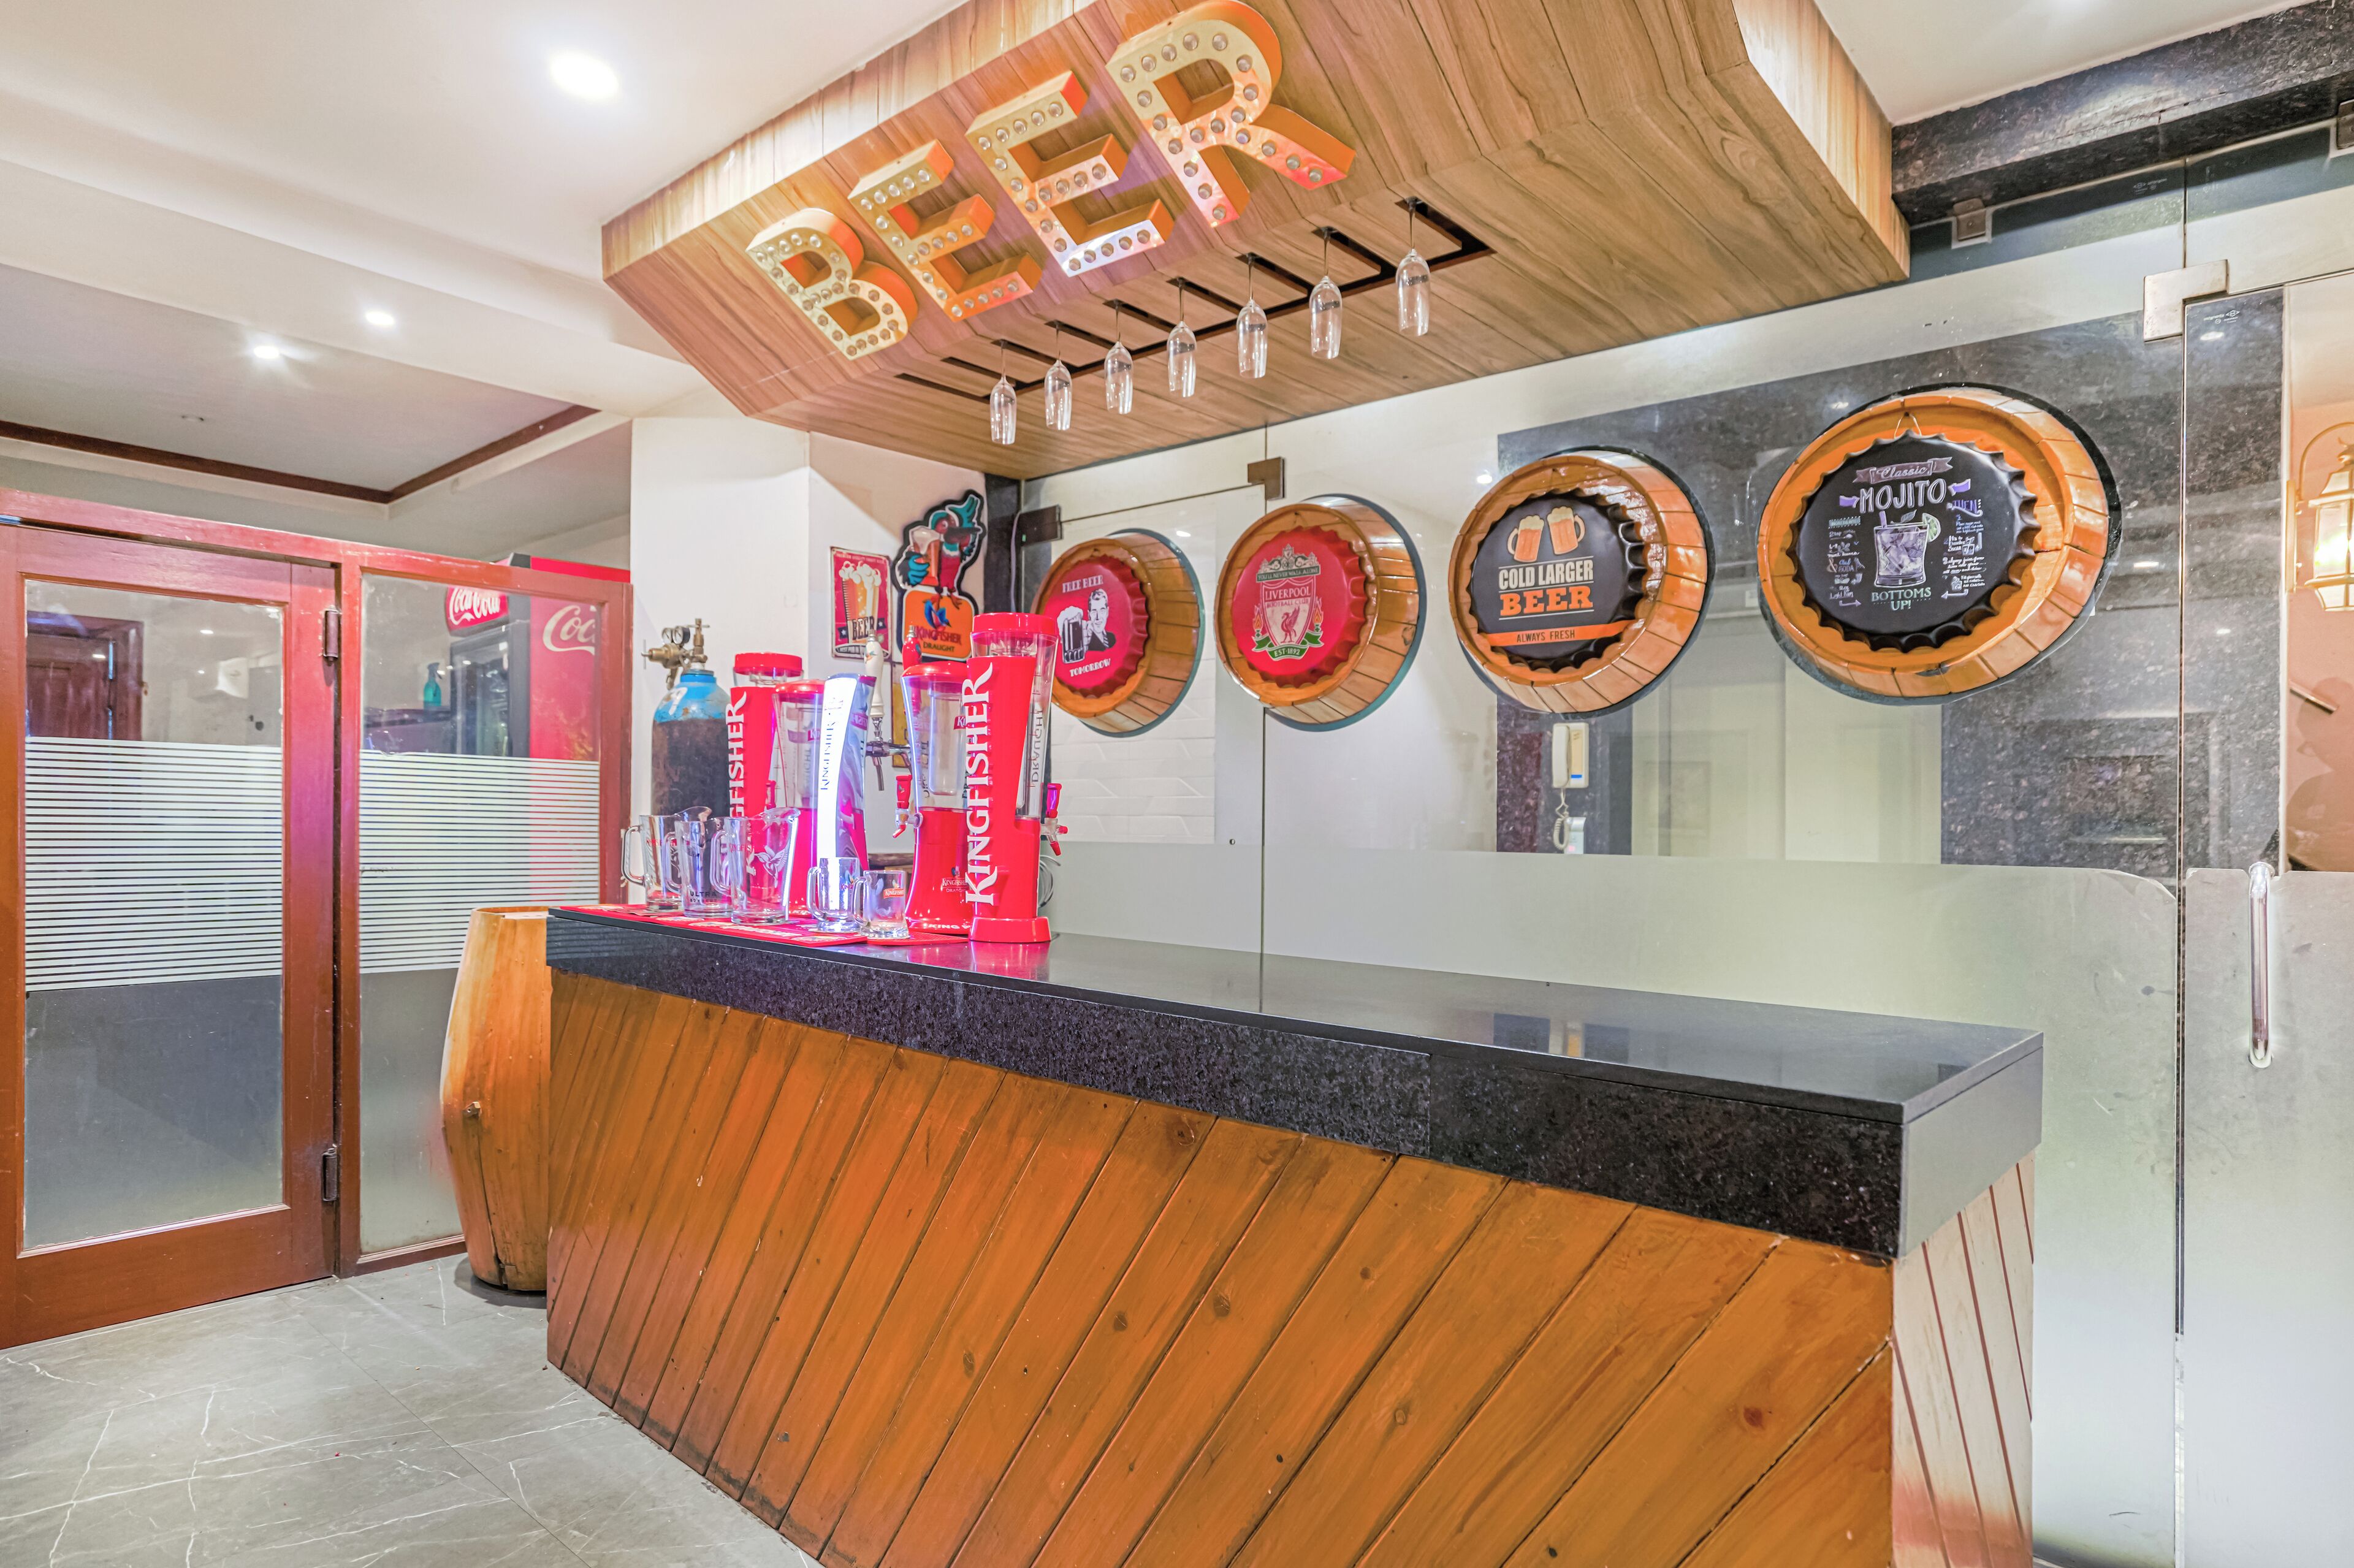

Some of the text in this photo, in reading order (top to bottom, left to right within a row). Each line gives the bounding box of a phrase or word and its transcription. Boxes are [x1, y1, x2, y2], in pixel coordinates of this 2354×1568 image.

[745, 1, 1355, 360] BEER
[1876, 466, 1928, 479] Classic
[1859, 478, 1947, 514] MOJITO
[1062, 575, 1103, 593] FREE BEER
[1499, 560, 1593, 590] COLD LARGER
[1265, 586, 1311, 601] LIVERPOOL
[1500, 585, 1593, 616] BEER
[1872, 587, 1931, 601] BOTTOMS
[1891, 600, 1911, 611] UP!
[852, 615, 875, 640] BEER
[915, 625, 962, 645] KINGFISHER
[1517, 630, 1575, 642] ALWAYS FRESH
[923, 642, 954, 652] DRAUGHT
[1069, 658, 1111, 677] TOMORROW
[962, 662, 998, 906] KINGFISHER
